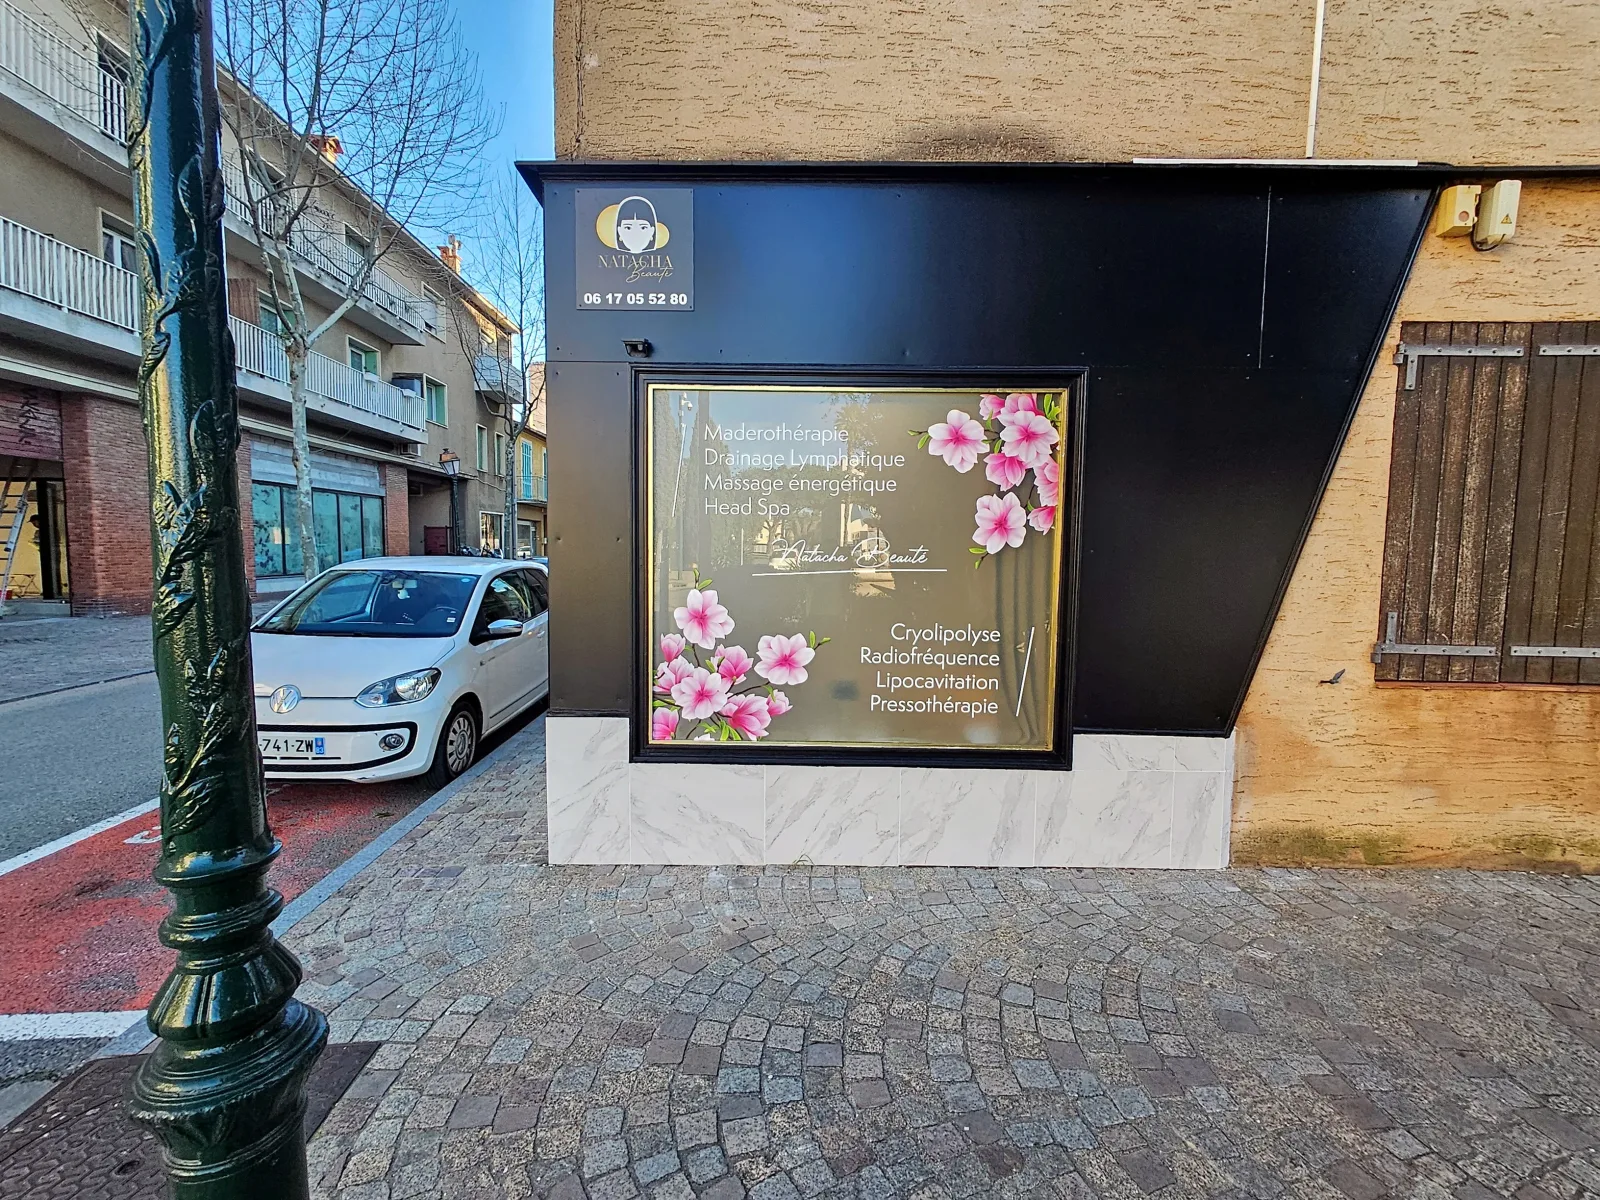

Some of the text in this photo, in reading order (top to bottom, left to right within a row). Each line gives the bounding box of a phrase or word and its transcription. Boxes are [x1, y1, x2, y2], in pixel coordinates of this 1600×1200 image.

[598, 255, 673, 268] NATACHA
[583, 293, 688, 305] 06 17 05 52 80
[704, 423, 849, 446] Maderothérapie
[704, 448, 906, 472] Drainage Lymphatique
[704, 473, 897, 496] Massage énergétique
[705, 497, 791, 518] Head Spa
[771, 537, 929, 568] Natacha Beauté
[890, 622, 1001, 647] Cryolipolyse
[860, 646, 1000, 670] Radiofréquence
[876, 670, 999, 693] Lipocavitation
[870, 694, 999, 718] Pressothérapie
